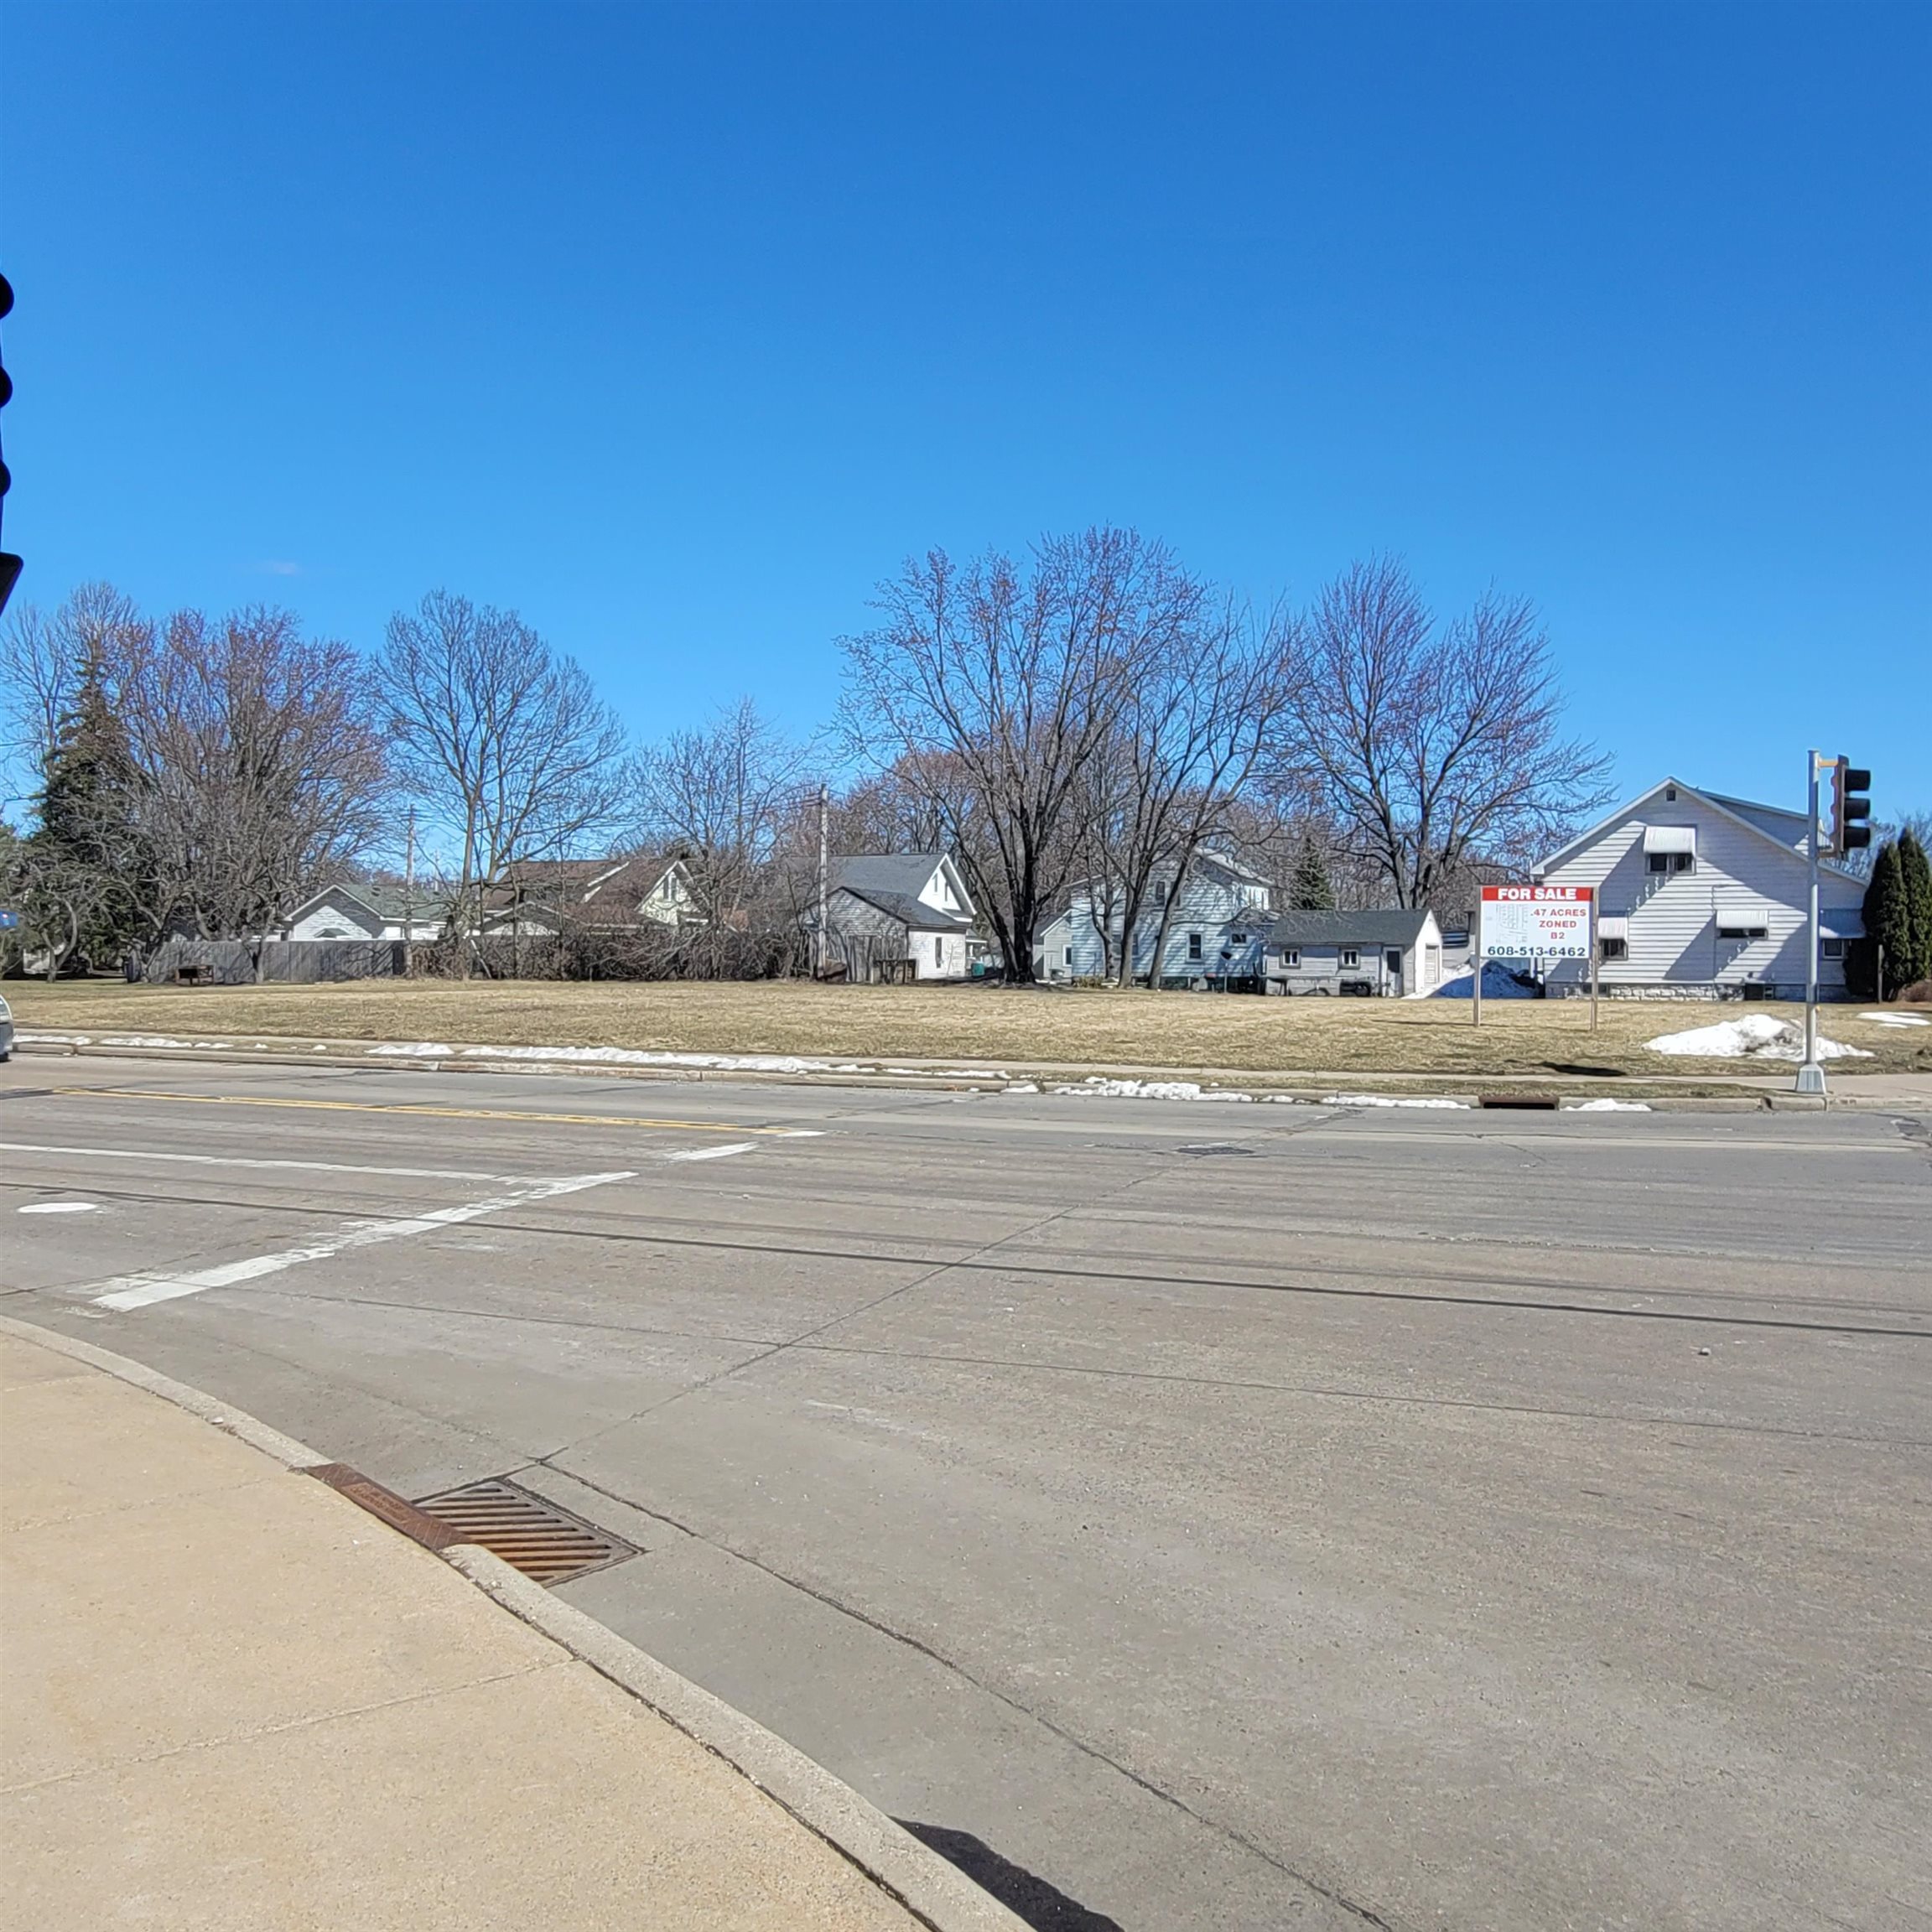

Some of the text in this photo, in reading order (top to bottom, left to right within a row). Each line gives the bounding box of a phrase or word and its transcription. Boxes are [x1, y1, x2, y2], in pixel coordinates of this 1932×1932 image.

[1498, 888, 1576, 900] FOR SALE
[1539, 920, 1576, 928] ZONED
[1488, 946, 1586, 957] 608-513-6462
